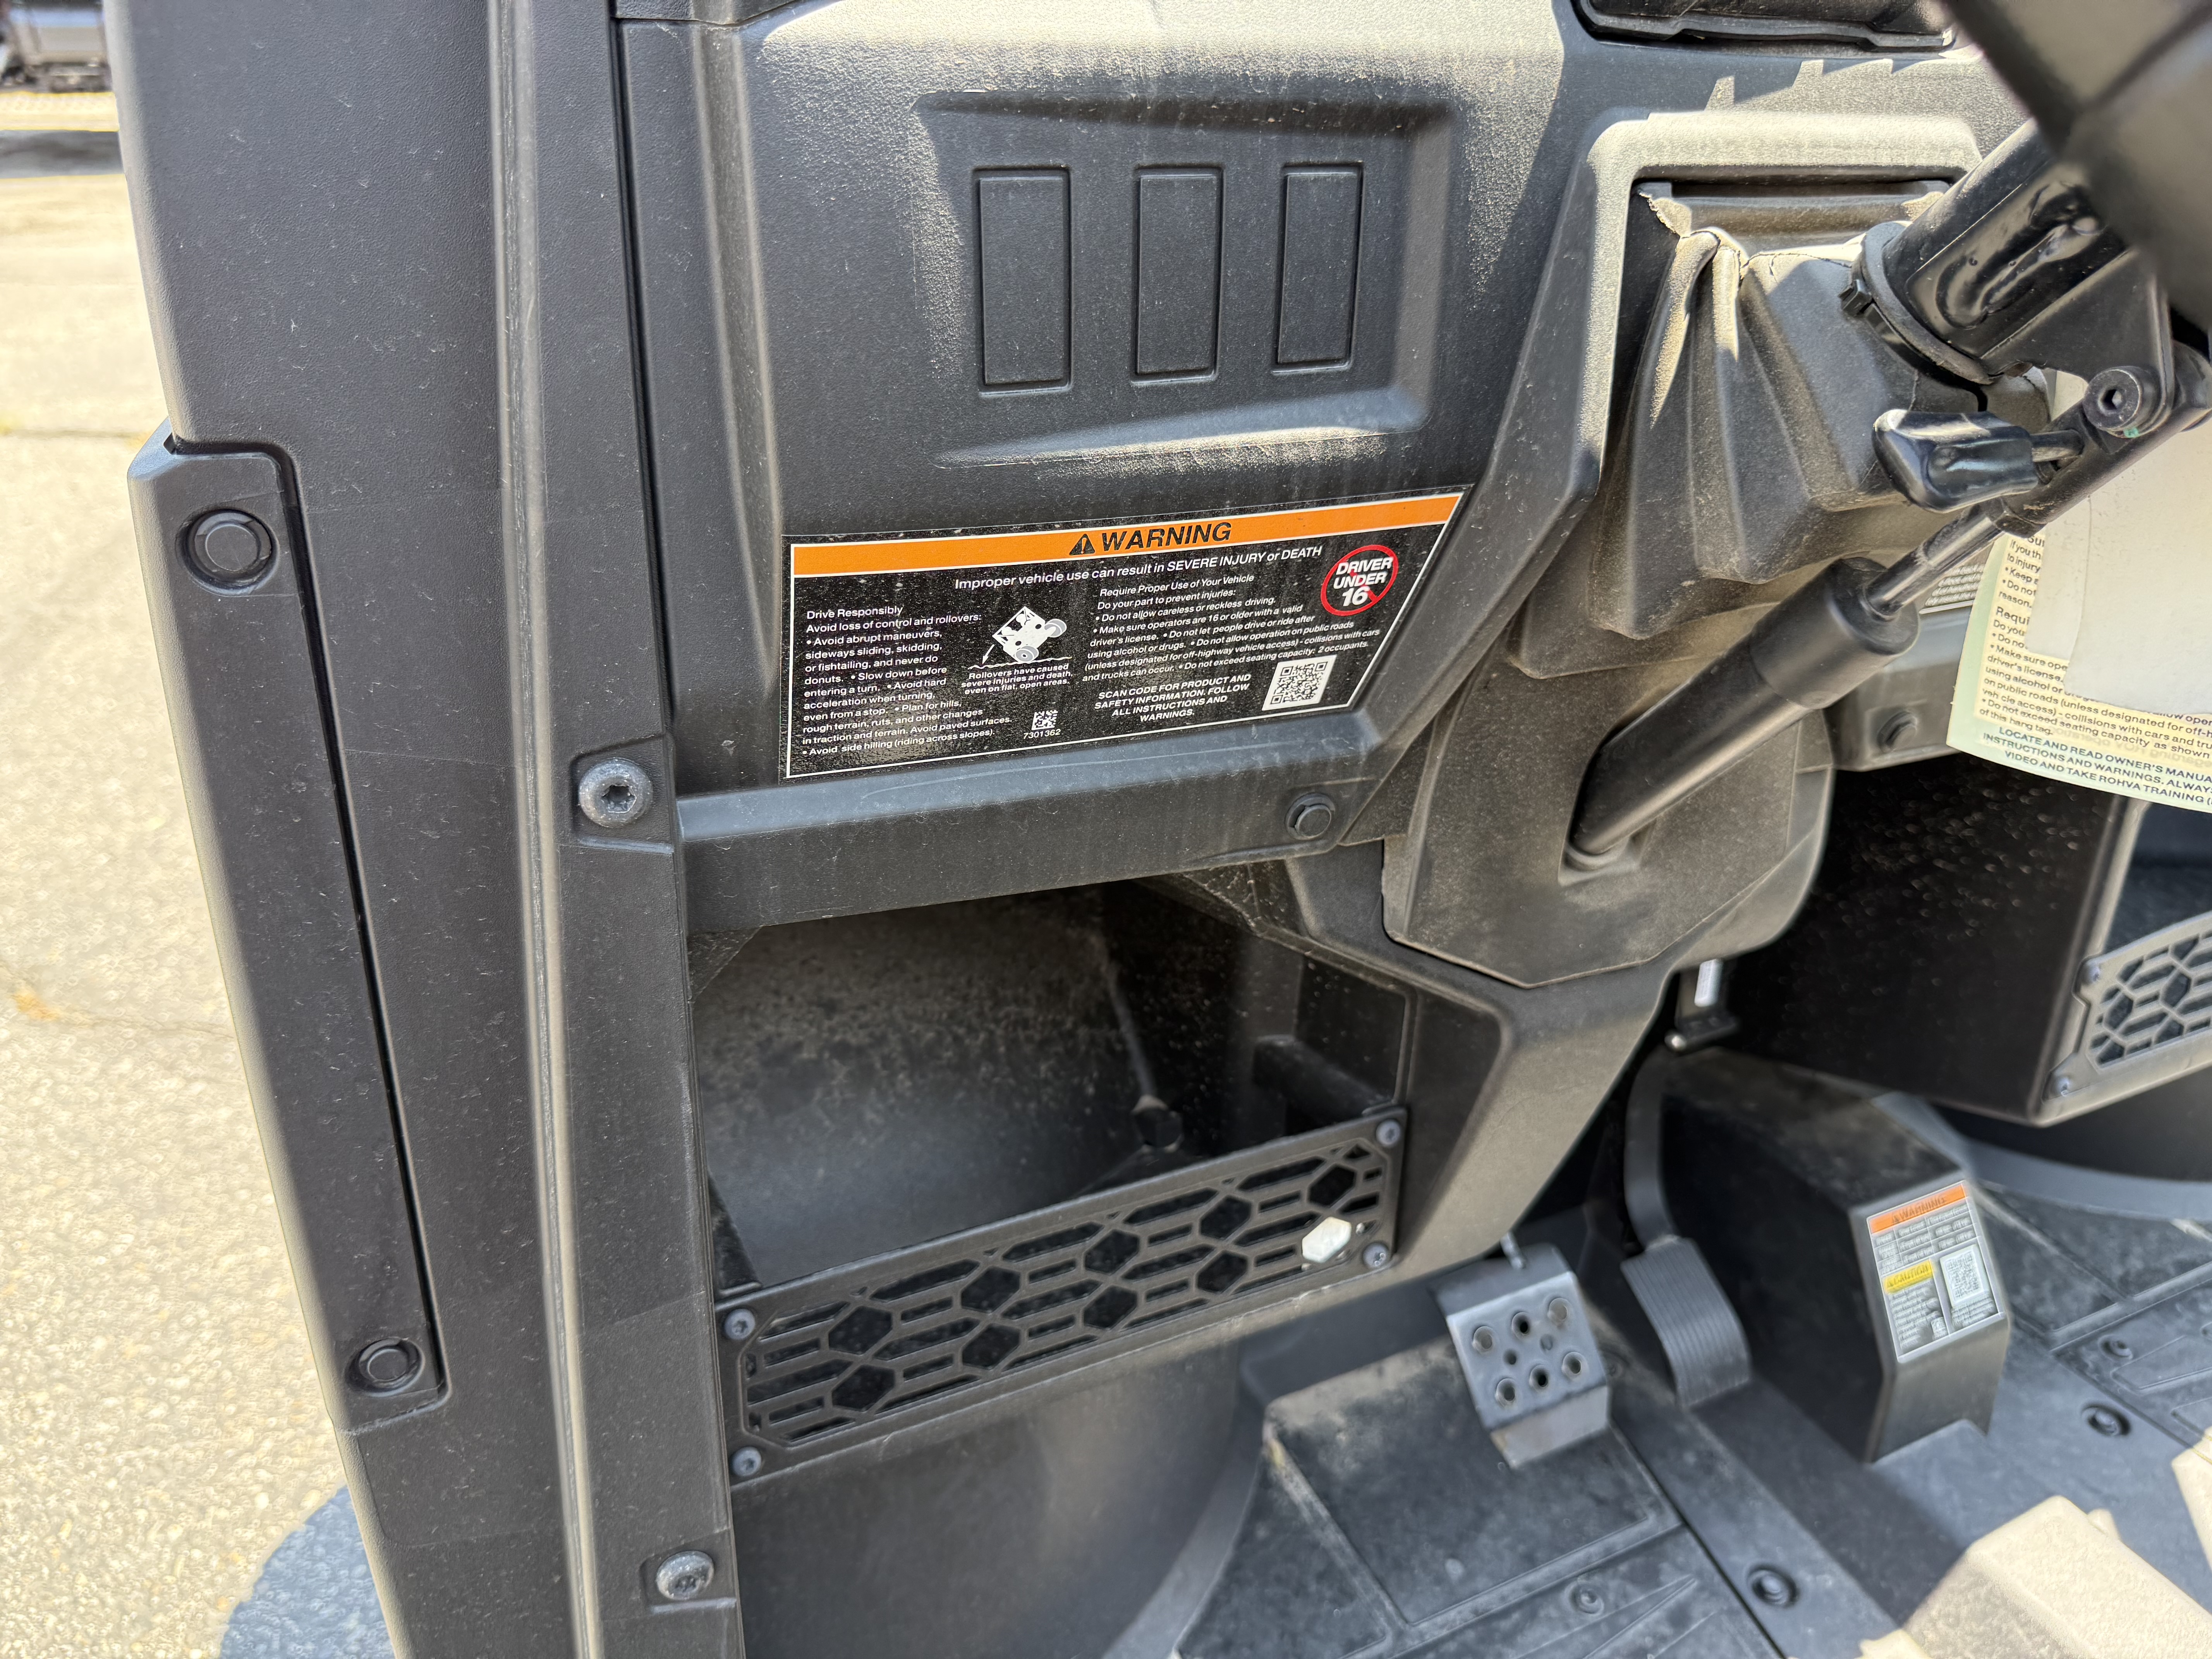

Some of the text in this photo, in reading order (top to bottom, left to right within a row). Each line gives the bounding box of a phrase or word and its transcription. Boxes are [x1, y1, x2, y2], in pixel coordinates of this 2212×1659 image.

[1102, 522, 1231, 551] WARNING
[955, 546, 1322, 590] Improper vehicle use can result in SEVERE INJURY or DEATH
[1336, 557, 1393, 575] DRIVER
[1100, 587, 1136, 598] Require
[1138, 584, 1169, 593] Proper
[1223, 575, 1254, 584] Vehicle
[1333, 572, 1388, 589] UNDER
[1112, 601, 1133, 611] your
[1135, 597, 1153, 608] part
[1166, 592, 1200, 605] prevent
[1202, 589, 1236, 601] injuries:
[1342, 586, 1370, 606] 16
[807, 606, 903, 619] Drive Responsibly
[1099, 625, 1124, 634] Make
[1148, 618, 1190, 630] operators
[1208, 613, 1218, 622] 16
[1231, 610, 1253, 619] older
[1255, 608, 1272, 616] with
[1283, 605, 1303, 613] valid
[1116, 611, 1131, 620] not
[1133, 610, 1156, 618] allow
[1158, 606, 1194, 616] careless
[1206, 601, 1242, 611] reckless
[1245, 598, 1275, 606] driving.
[806, 613, 981, 633] Avoid loss of control and rollovers:
[814, 631, 942, 646] Avoid abrupt maneuvers,
[805, 643, 942, 659] sideways sliding, skidding,
[819, 660, 871, 671] fishtailing,
[874, 658, 893, 666] and
[895, 657, 923, 665] never
[926, 654, 938, 663] do
[969, 670, 1012, 679] Rollovers
[1037, 663, 1069, 673] caused
[805, 667, 947, 685] donuts. Slow down before
[993, 676, 1026, 686] injuries
[1046, 670, 1073, 679] death,
[1020, 682, 1041, 690] open
[1098, 674, 1251, 699] SCAN CODE FOR PRODUCT AND
[804, 687, 846, 697] entering
[857, 685, 880, 693] turn.
[894, 680, 921, 690] Avoid
[924, 678, 946, 687] hard
[1095, 683, 1250, 709] SAFETY INFORMATION. FOLLOW
[804, 691, 935, 709] acceleration when turning,
[804, 713, 828, 721] even
[831, 711, 852, 719] from
[863, 707, 888, 716] stop.
[902, 703, 923, 712] Plan
[926, 702, 938, 710] for
[940, 699, 962, 709] hills,
[1112, 695, 1228, 716] ALL INSTRUCTIONS AND
[1984, 678, 1995, 687] on
[1997, 682, 2027, 696] public
[2029, 692, 2058, 704] roads
[2061, 699, 2099, 714] (unless
[2101, 709, 2164, 728] designated
[2167, 722, 2183, 732] for
[803, 709, 982, 733] rough terrain, ruts, and other changes
[1140, 708, 1194, 721] WARNINGS.
[802, 716, 1012, 744] in traction and terrain. Avoid paved surfaces.
[1023, 728, 1061, 739] 7301362
[809, 727, 994, 755] Avoid side hilling (riding across slopes).
[1999, 727, 2163, 773] LOCATE AND READ OWNER'S
[1984, 732, 2065, 761] INSTRUCTIONS
[2067, 757, 2092, 768] AND
[2095, 763, 2164, 784] WARNINGS.
[2005, 750, 2204, 802] VIDEO AND TAKE ROHVA TRAINING
